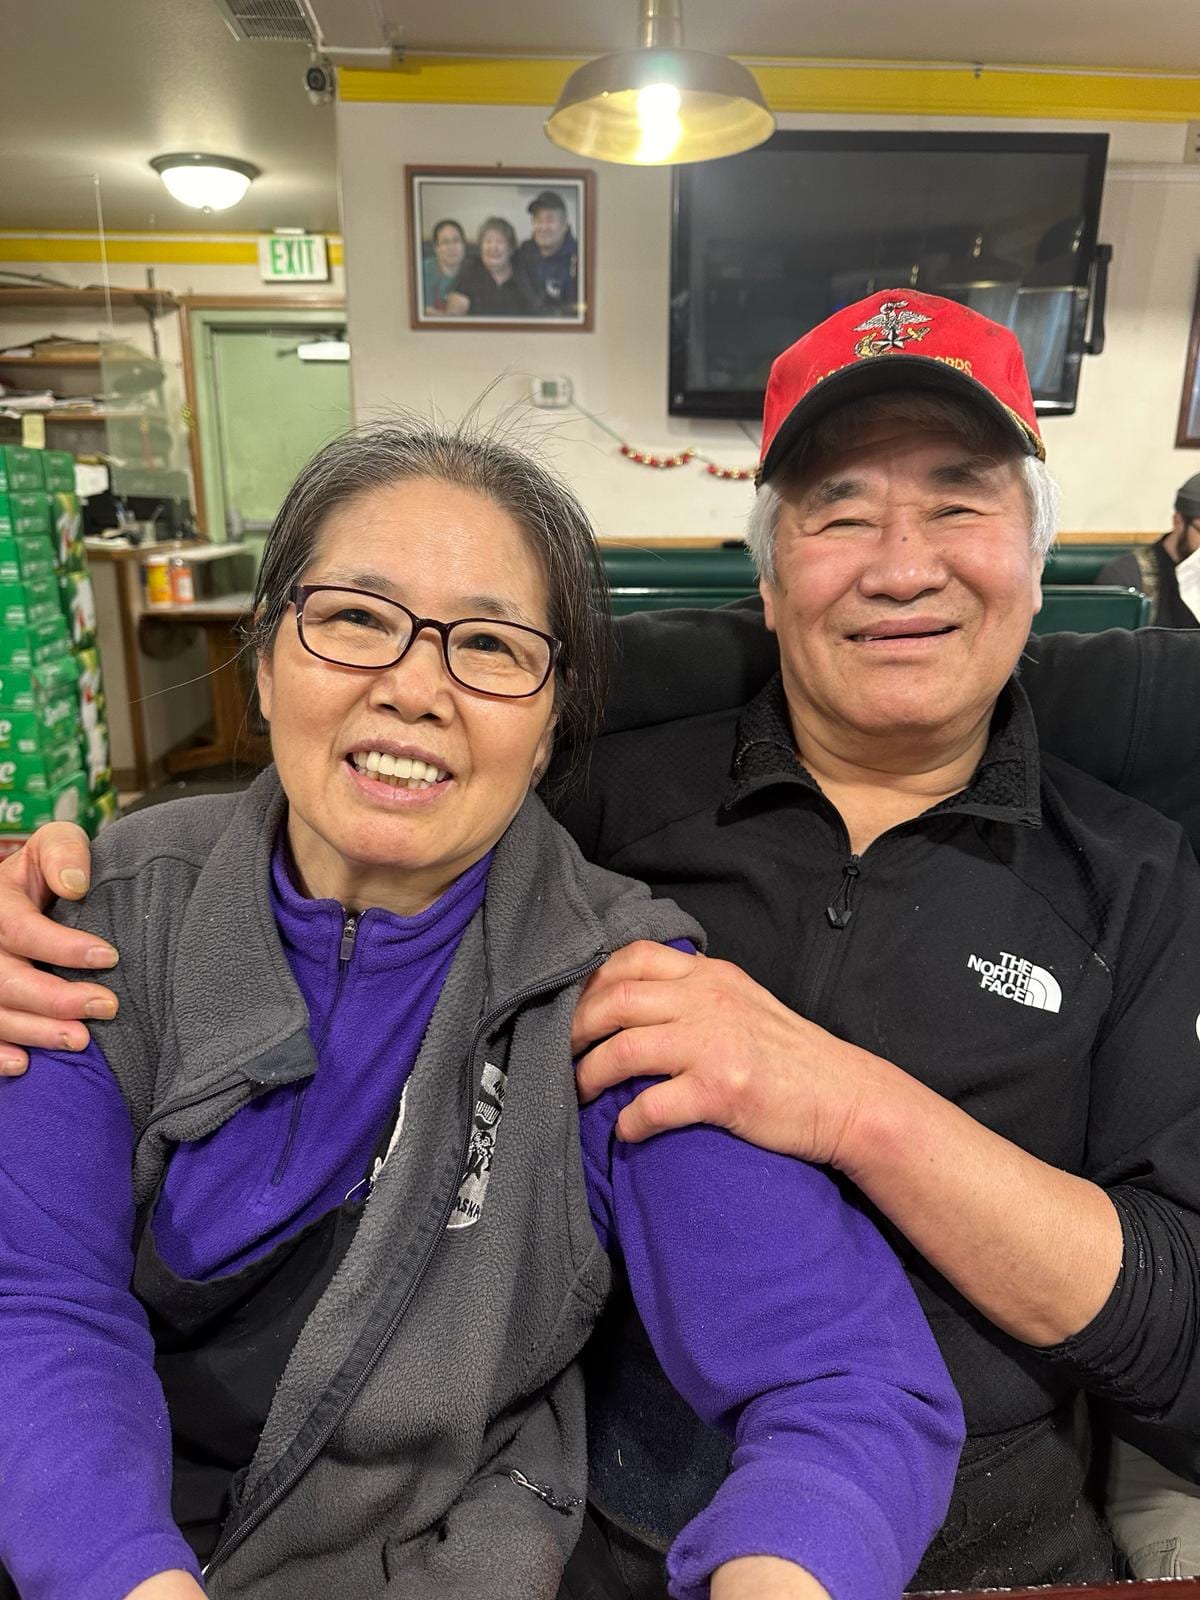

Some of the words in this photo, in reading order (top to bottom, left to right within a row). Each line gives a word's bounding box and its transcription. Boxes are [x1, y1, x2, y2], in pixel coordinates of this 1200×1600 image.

[270, 238, 315, 274] EXIT
[967, 954, 1030, 990] NORTH
[1000, 951, 1033, 976] THE
[980, 975, 1026, 1004] FACE
